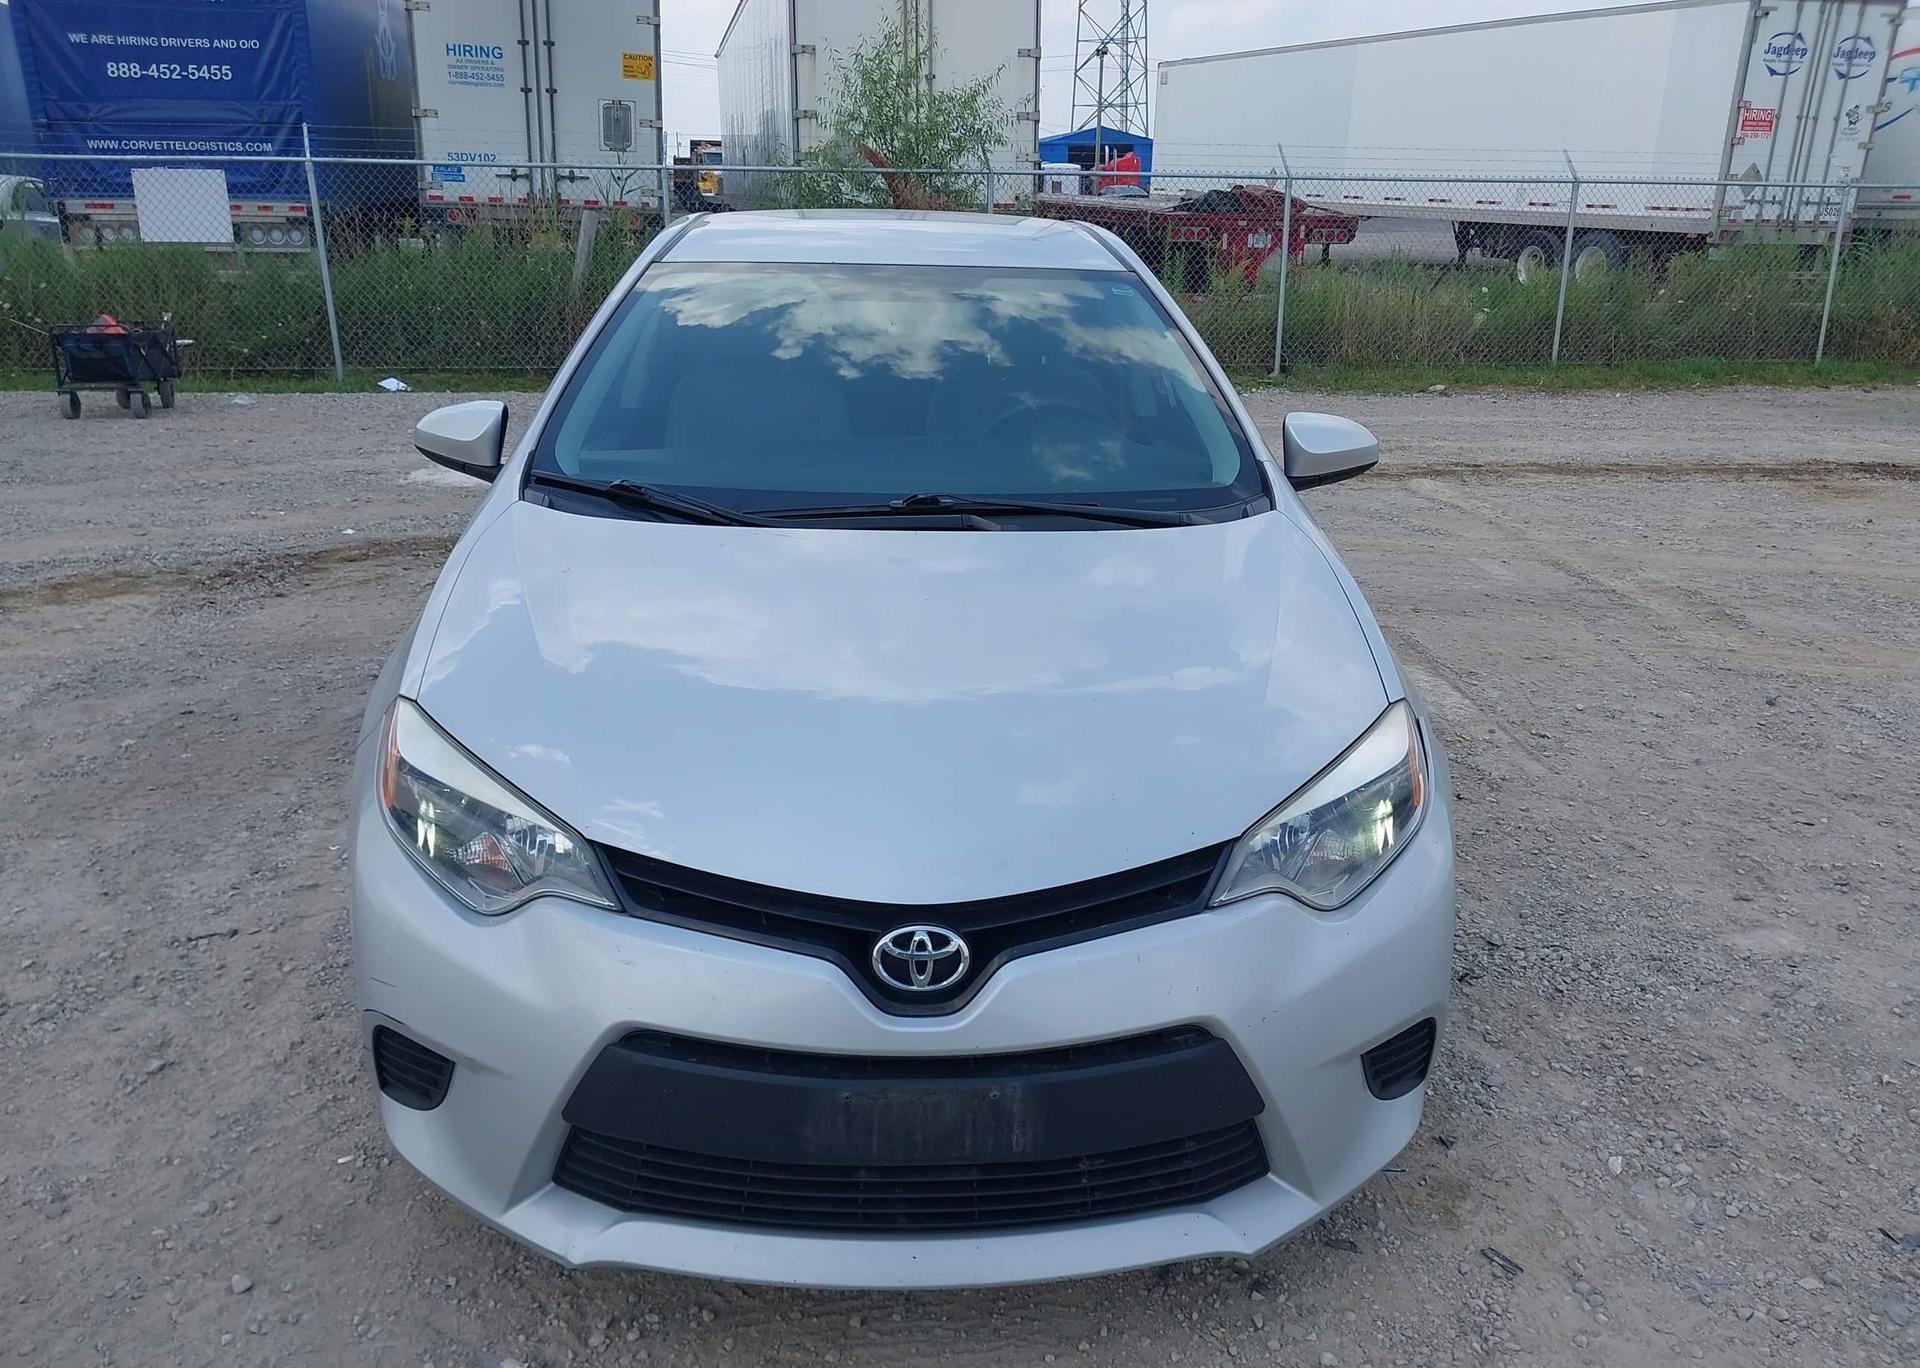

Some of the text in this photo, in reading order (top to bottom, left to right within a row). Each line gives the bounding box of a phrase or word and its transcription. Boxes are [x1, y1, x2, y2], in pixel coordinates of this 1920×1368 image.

[67, 32, 260, 49] WE ARE HIRING DRIVERS AND O/O
[446, 43, 504, 60] HIRING
[623, 53, 654, 61] CAUTION
[1833, 46, 1876, 62] Jagdeep
[106, 62, 232, 80] 888-452-5455
[448, 70, 505, 82] 1-888-452-5455
[1743, 108, 1775, 121] HIRING!
[86, 139, 273, 152] WWW.CORVETTELOGISTICS.COM
[447, 151, 497, 162] 53DV102
